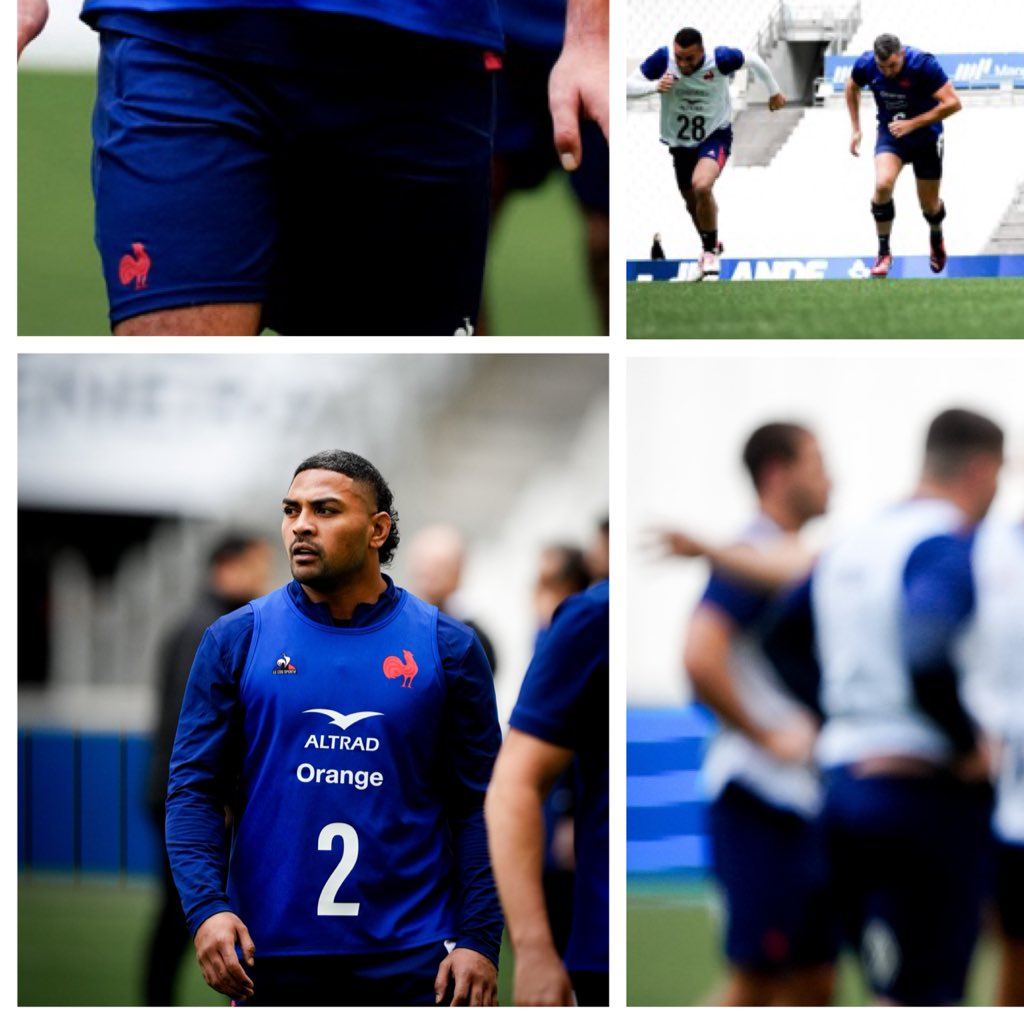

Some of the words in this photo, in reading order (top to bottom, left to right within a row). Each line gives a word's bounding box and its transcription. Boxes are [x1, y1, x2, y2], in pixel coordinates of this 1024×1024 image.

[677, 113, 706, 141] 28
[304, 734, 380, 752] ALTRAD
[296, 763, 384, 790] Orange
[316, 822, 361, 916] 2
